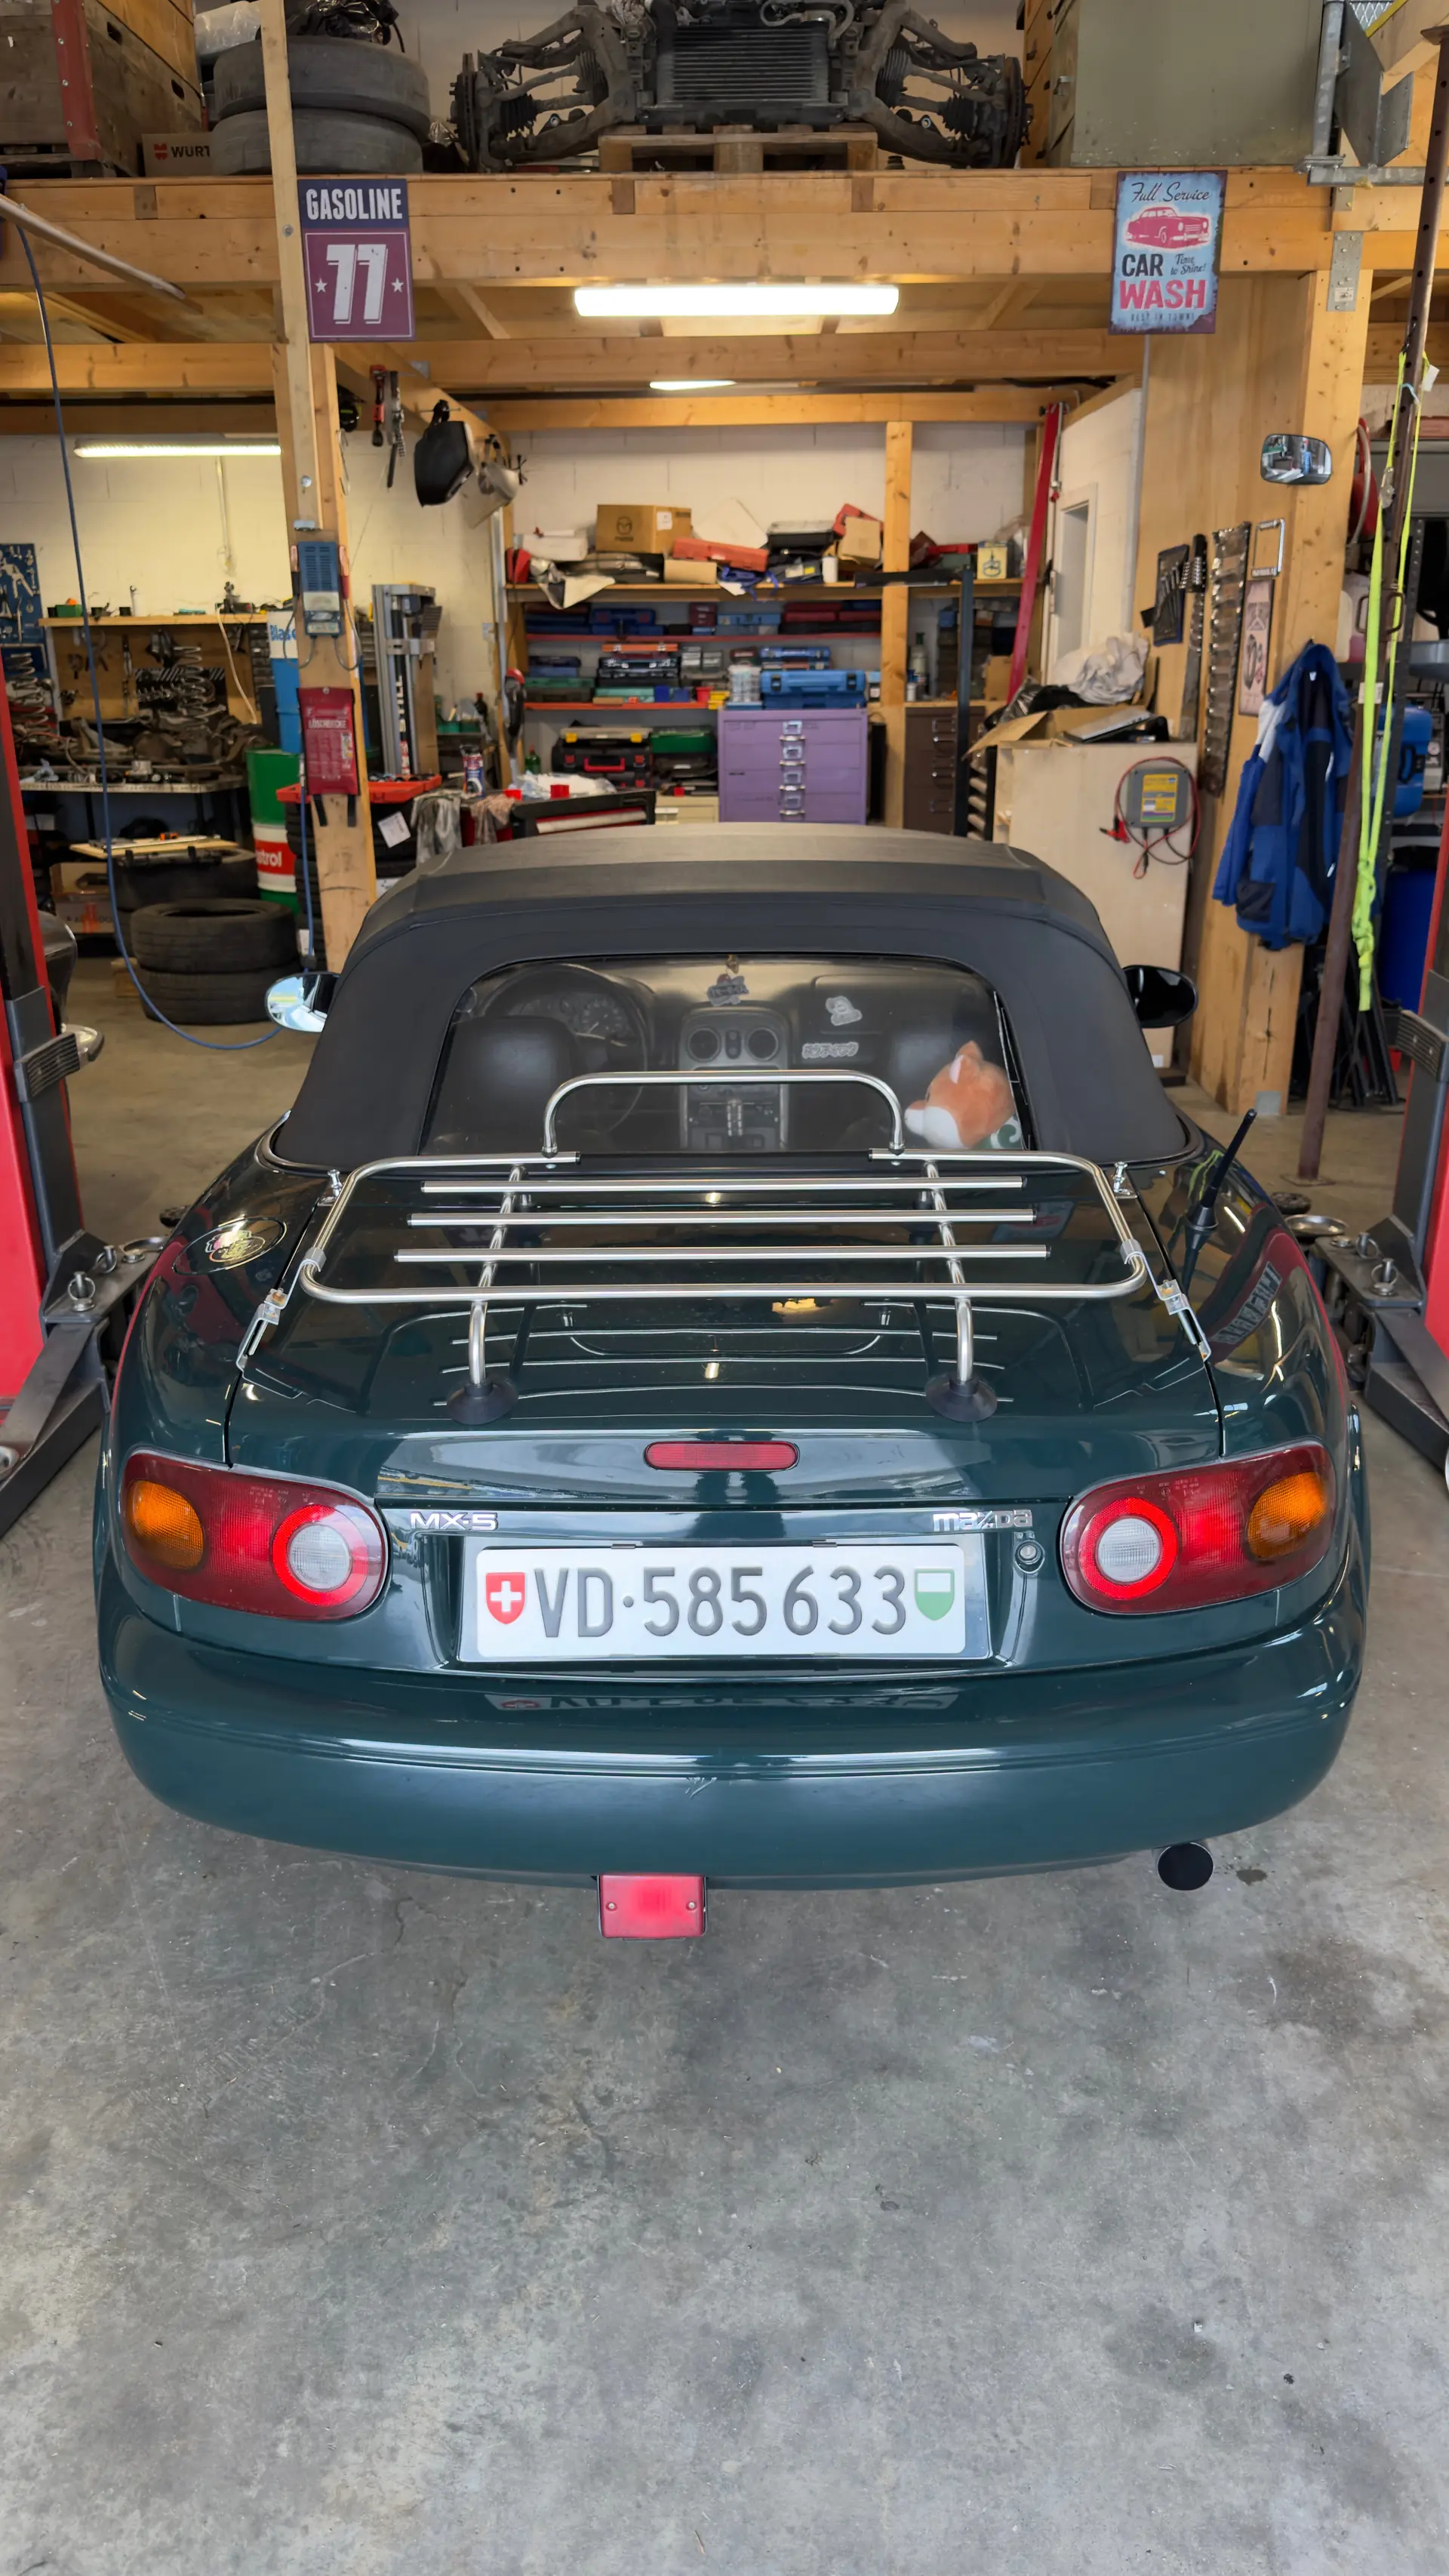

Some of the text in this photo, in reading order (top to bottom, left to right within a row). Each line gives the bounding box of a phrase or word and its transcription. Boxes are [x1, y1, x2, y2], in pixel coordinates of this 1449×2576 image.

[1131, 181, 1210, 202] Full Service
[306, 188, 403, 220] GASOLINE
[1121, 254, 1164, 277] CAR
[1171, 266, 1179, 275] to
[1175, 254, 1195, 265] Time
[326, 244, 389, 325] 77
[1119, 279, 1208, 309] WASH
[410, 1511, 499, 1531] MX-5
